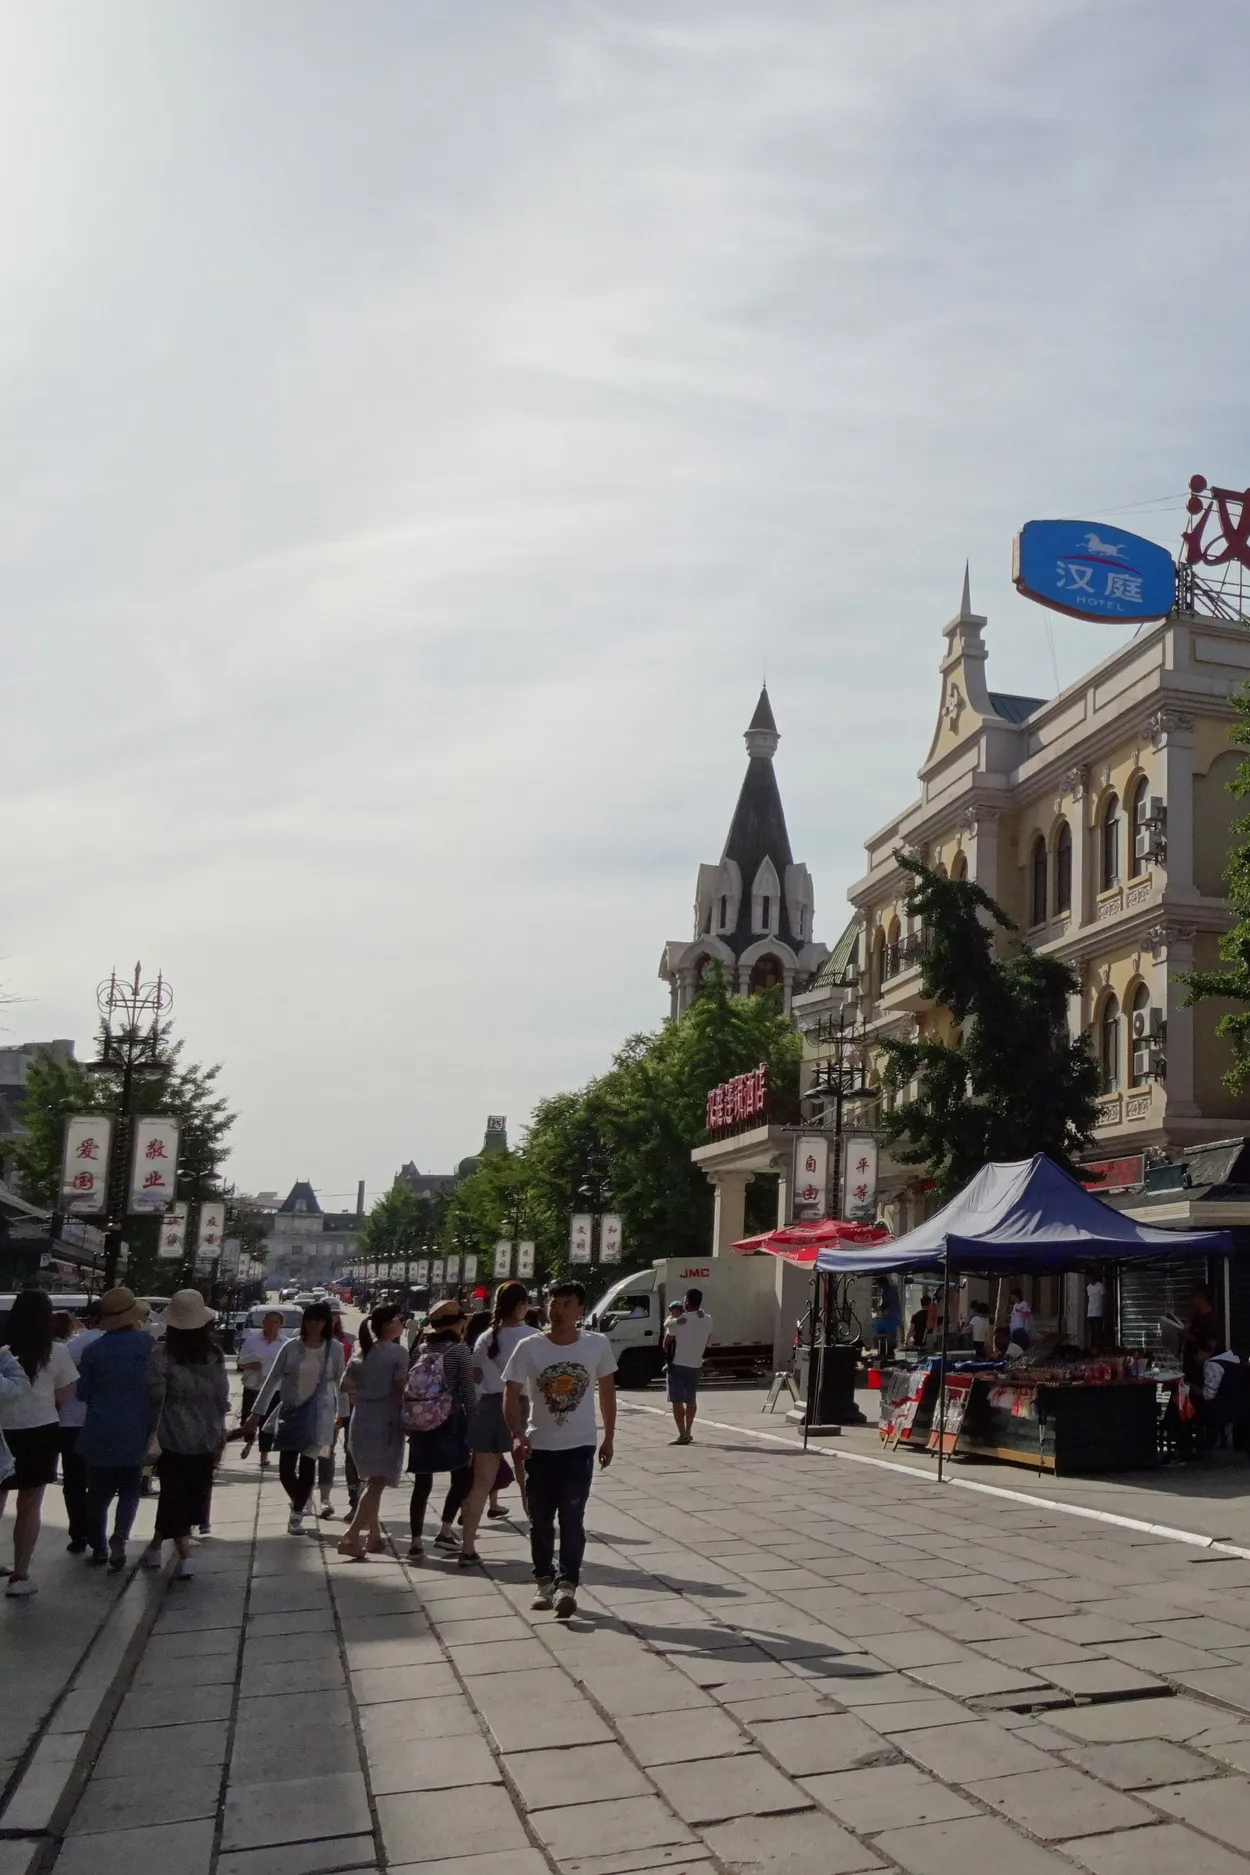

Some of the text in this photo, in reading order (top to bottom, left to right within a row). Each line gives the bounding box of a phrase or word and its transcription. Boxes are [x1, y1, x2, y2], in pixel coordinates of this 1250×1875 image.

[1055, 559, 1144, 603] 汉庭
[1076, 594, 1126, 612] HOTEL
[73, 1137, 99, 1191] 爱国
[142, 1138, 168, 1189] 敬业
[801, 1154, 819, 1201] 自由
[853, 1157, 870, 1202] 平等
[576, 1225, 587, 1252] 文明
[606, 1225, 618, 1252] 和谐
[679, 1268, 710, 1279] JMC
